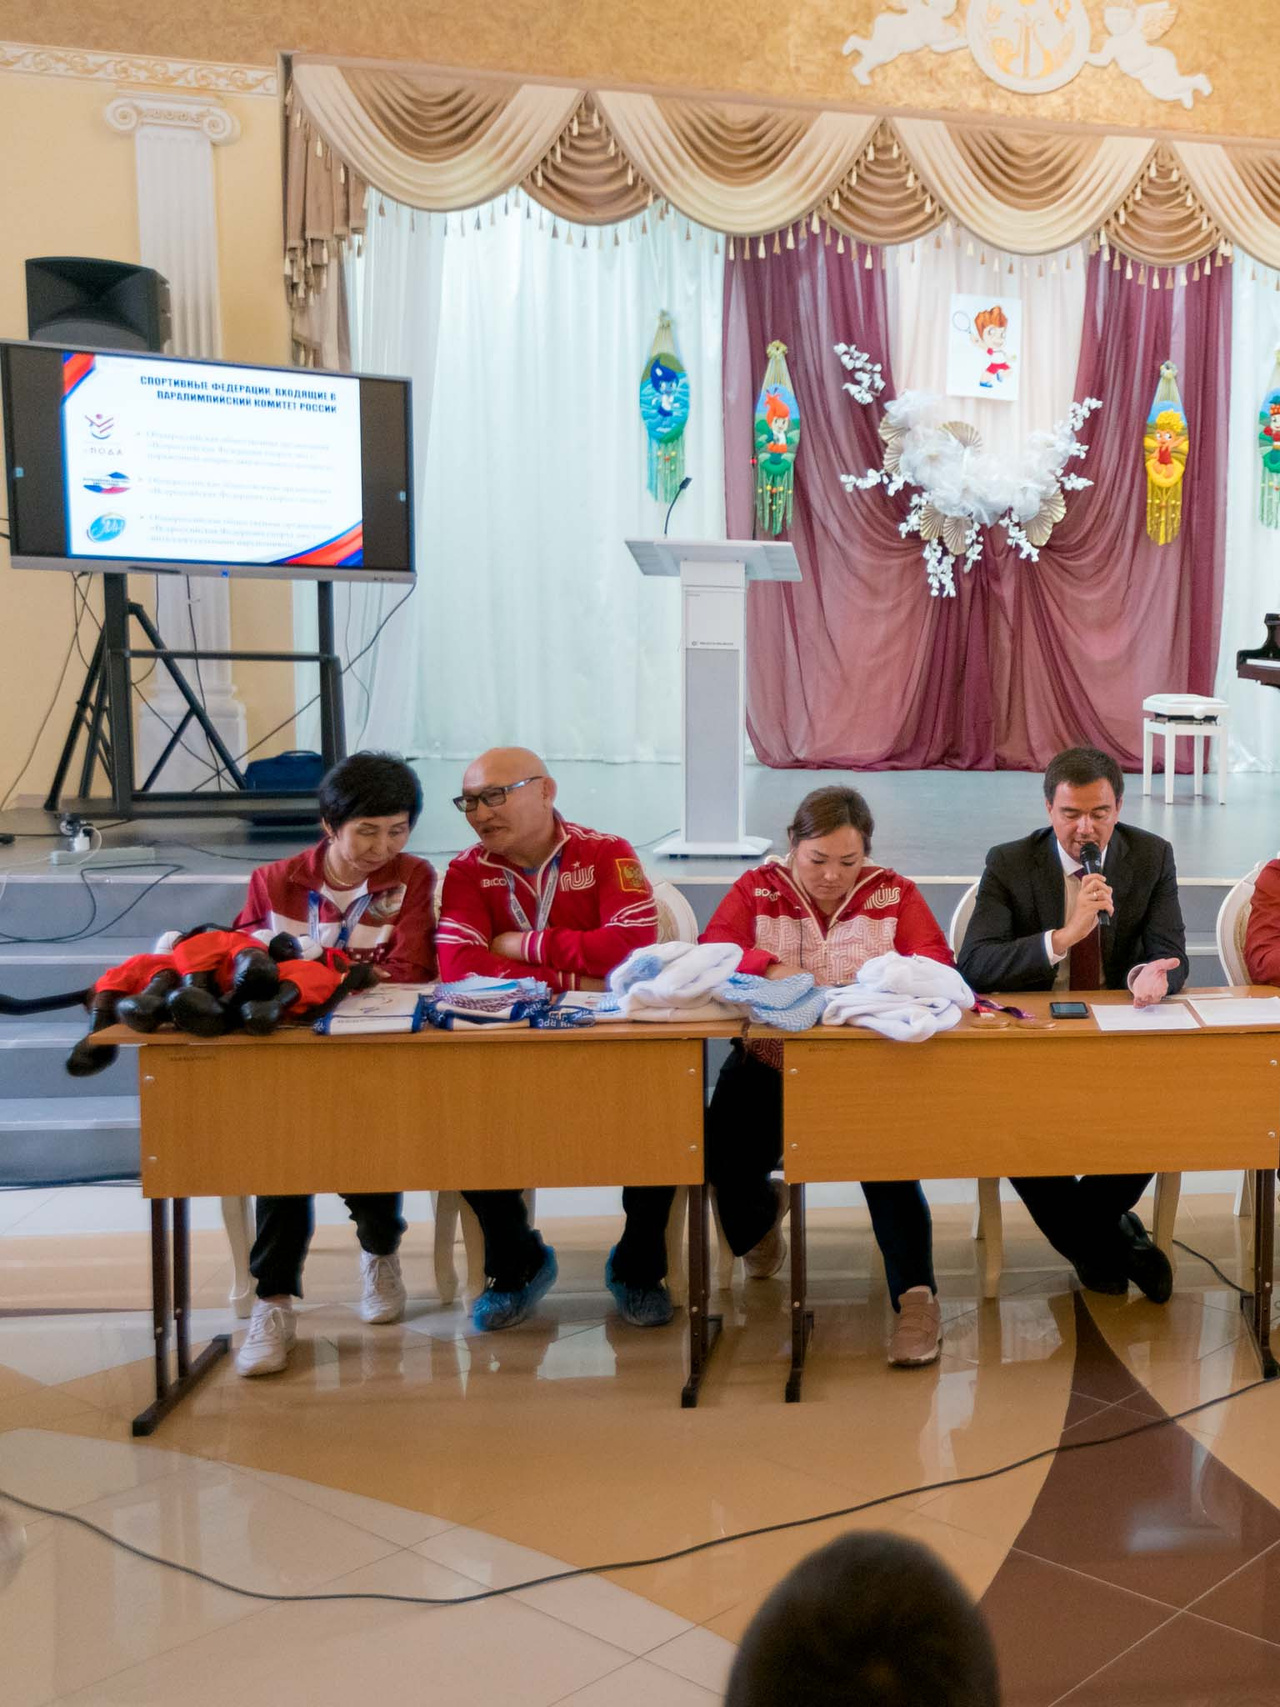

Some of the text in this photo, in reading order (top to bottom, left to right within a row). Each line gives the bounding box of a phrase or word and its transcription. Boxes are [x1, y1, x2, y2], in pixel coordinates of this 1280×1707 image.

[140, 376, 208, 390] СПОРТИВНЫЕ
[157, 390, 337, 414] ПАРАЛИМПИЙСКИЙ КОМИТЕТ РОССИИ
